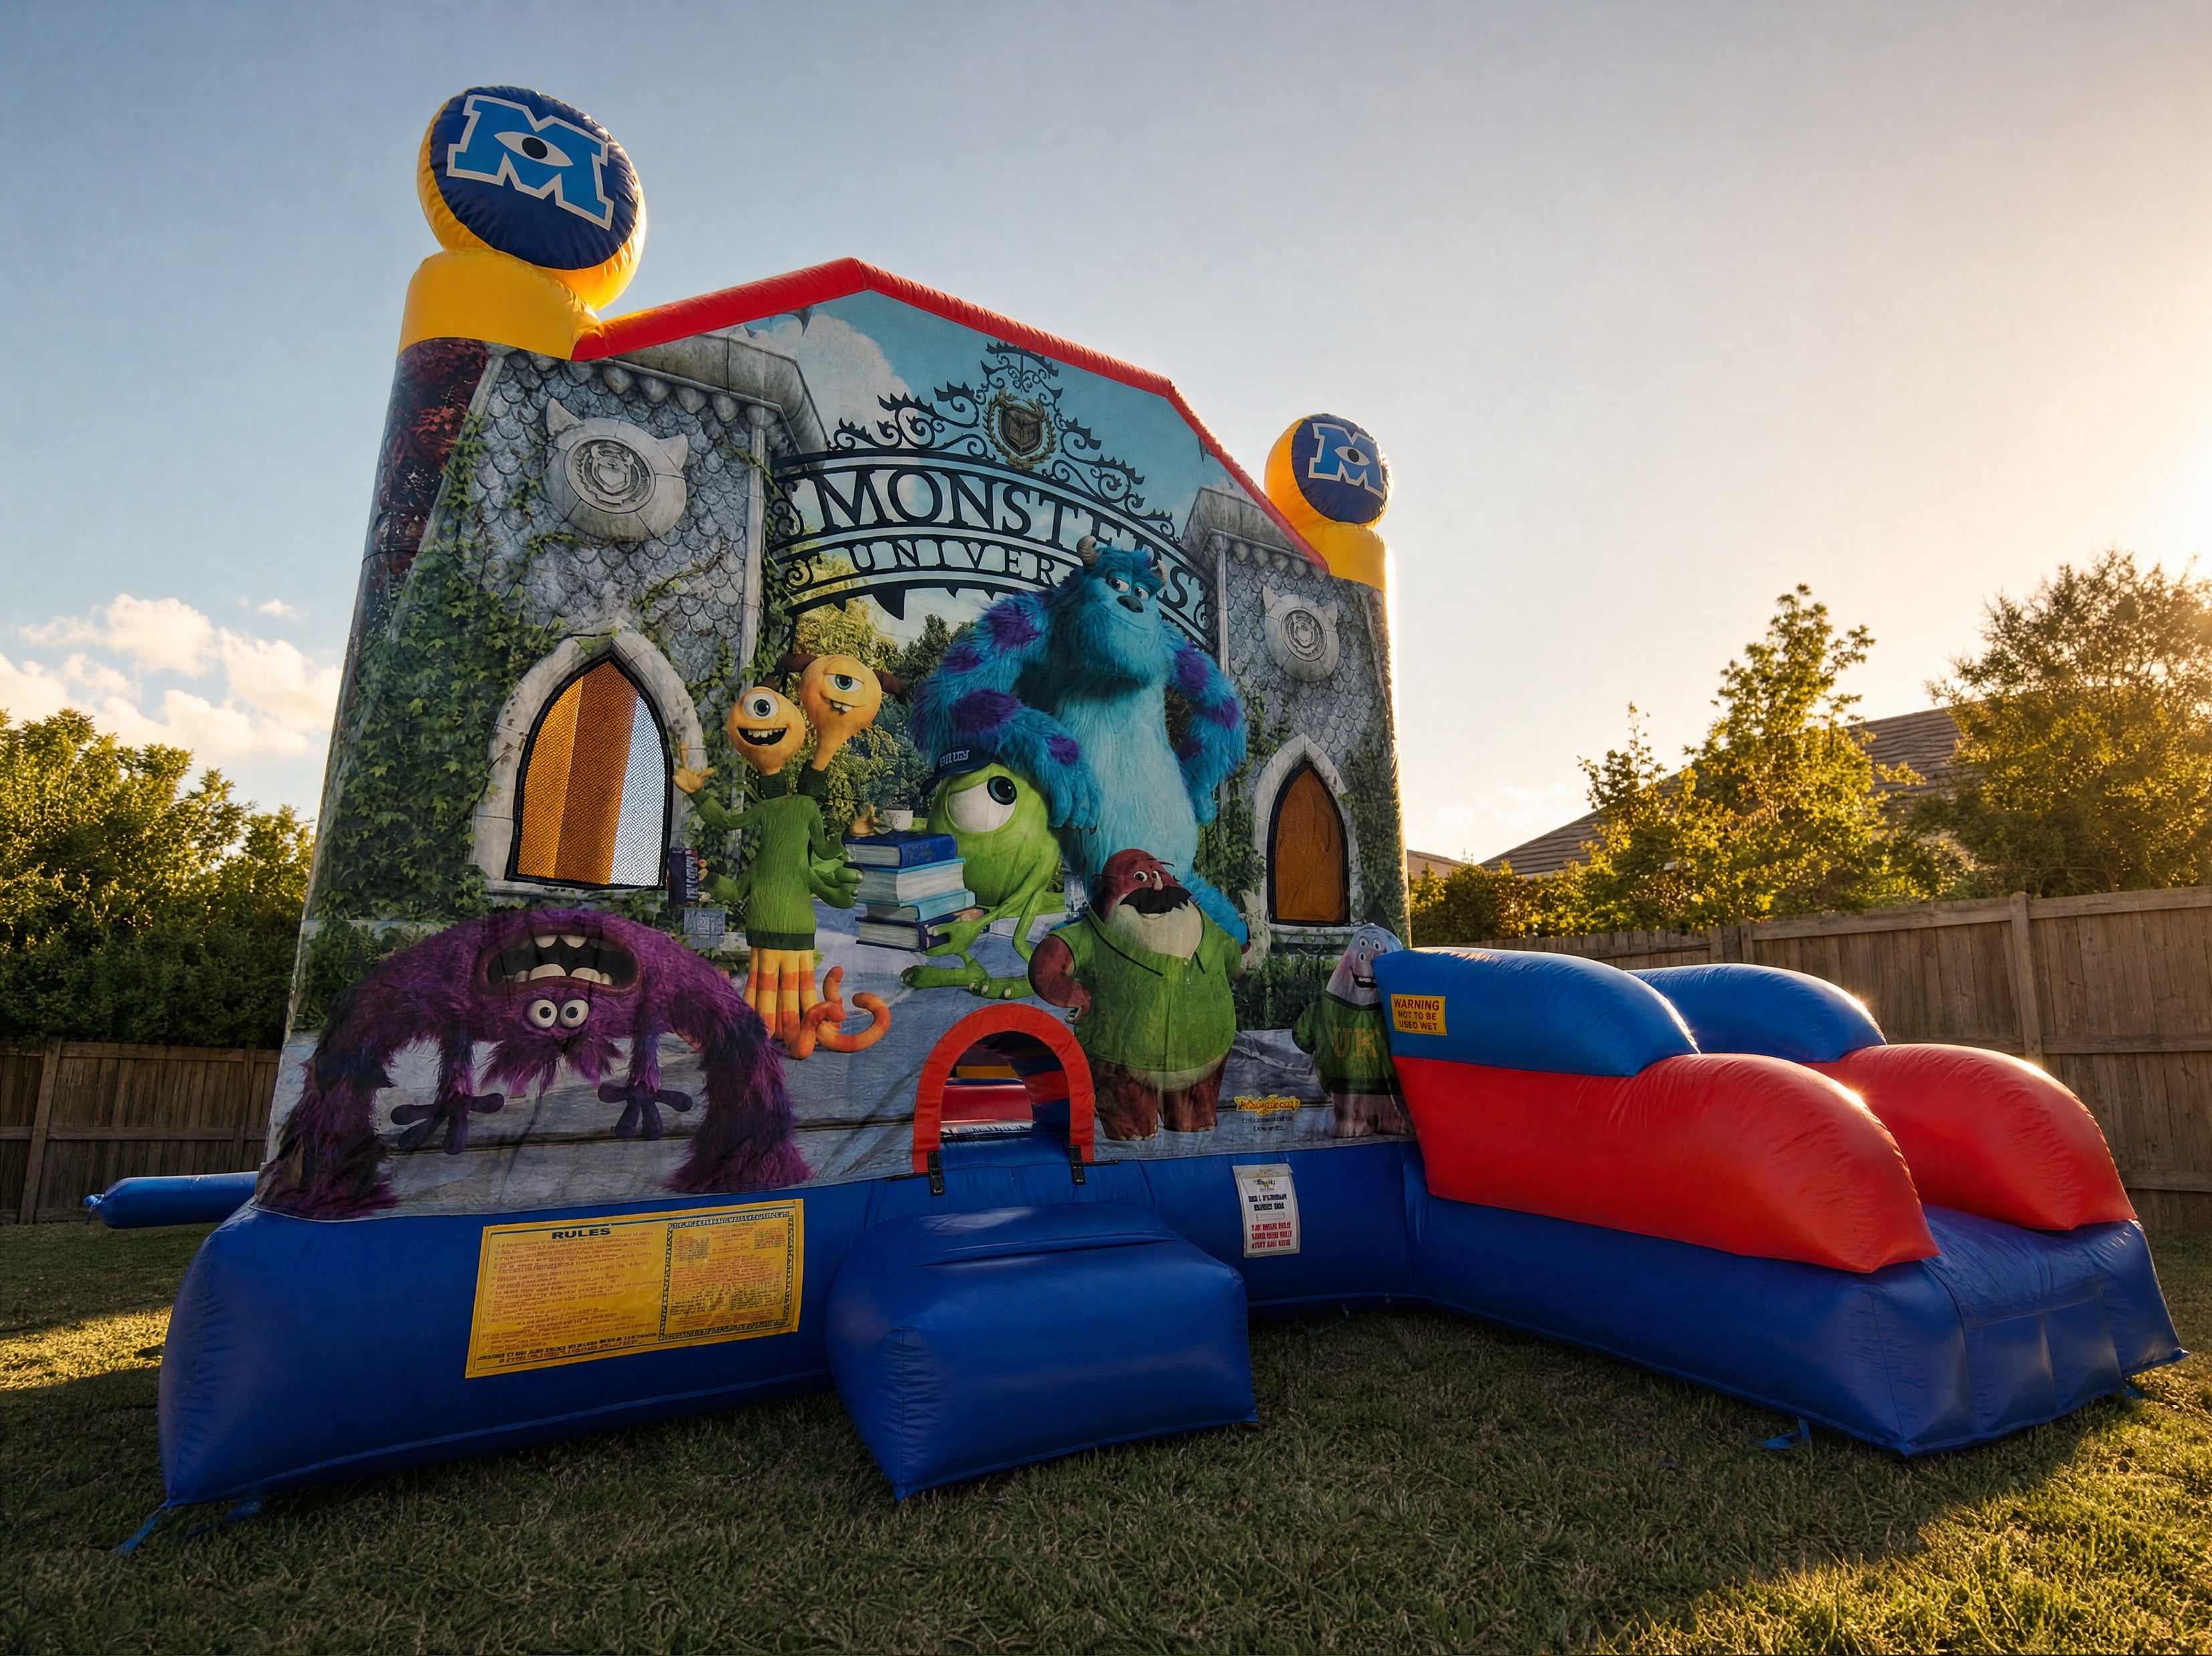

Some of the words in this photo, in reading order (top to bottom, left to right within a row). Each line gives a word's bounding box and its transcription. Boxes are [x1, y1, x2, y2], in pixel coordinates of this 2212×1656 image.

[1394, 998, 1439, 1010] WARNING
[1398, 1010, 1412, 1018] NOT
[1414, 1012, 1423, 1020] TO
[1399, 1020, 1417, 1029] USED
[1420, 1022, 1437, 1030] WET
[1333, 1026, 1380, 1058] UK
[552, 1228, 611, 1239] RULES
